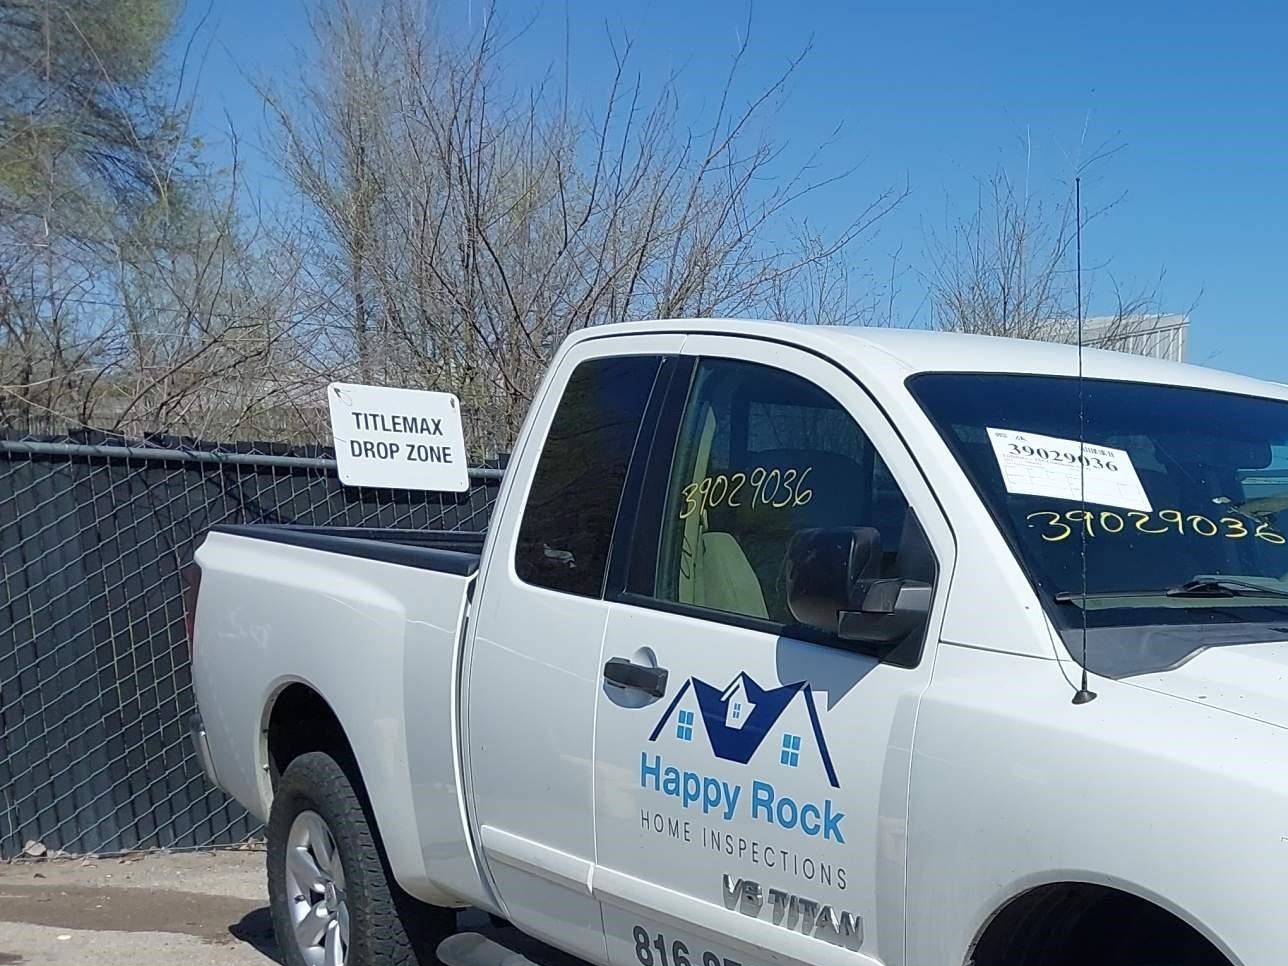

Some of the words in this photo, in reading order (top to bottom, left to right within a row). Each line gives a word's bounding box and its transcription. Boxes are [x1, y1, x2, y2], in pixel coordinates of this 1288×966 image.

[352, 412, 443, 436] TITLEMAX
[350, 440, 400, 460] DROP
[406, 444, 453, 463] ZONE
[1008, 443, 1118, 472] 39029036
[678, 467, 813, 518] 39029036
[1026, 510, 1286, 544] 39029036
[640, 751, 742, 821] Happy
[752, 780, 846, 845] Rock
[640, 809, 692, 843] HOME
[702, 827, 848, 891] INSPECTIONS
[768, 888, 864, 945] TITAN
